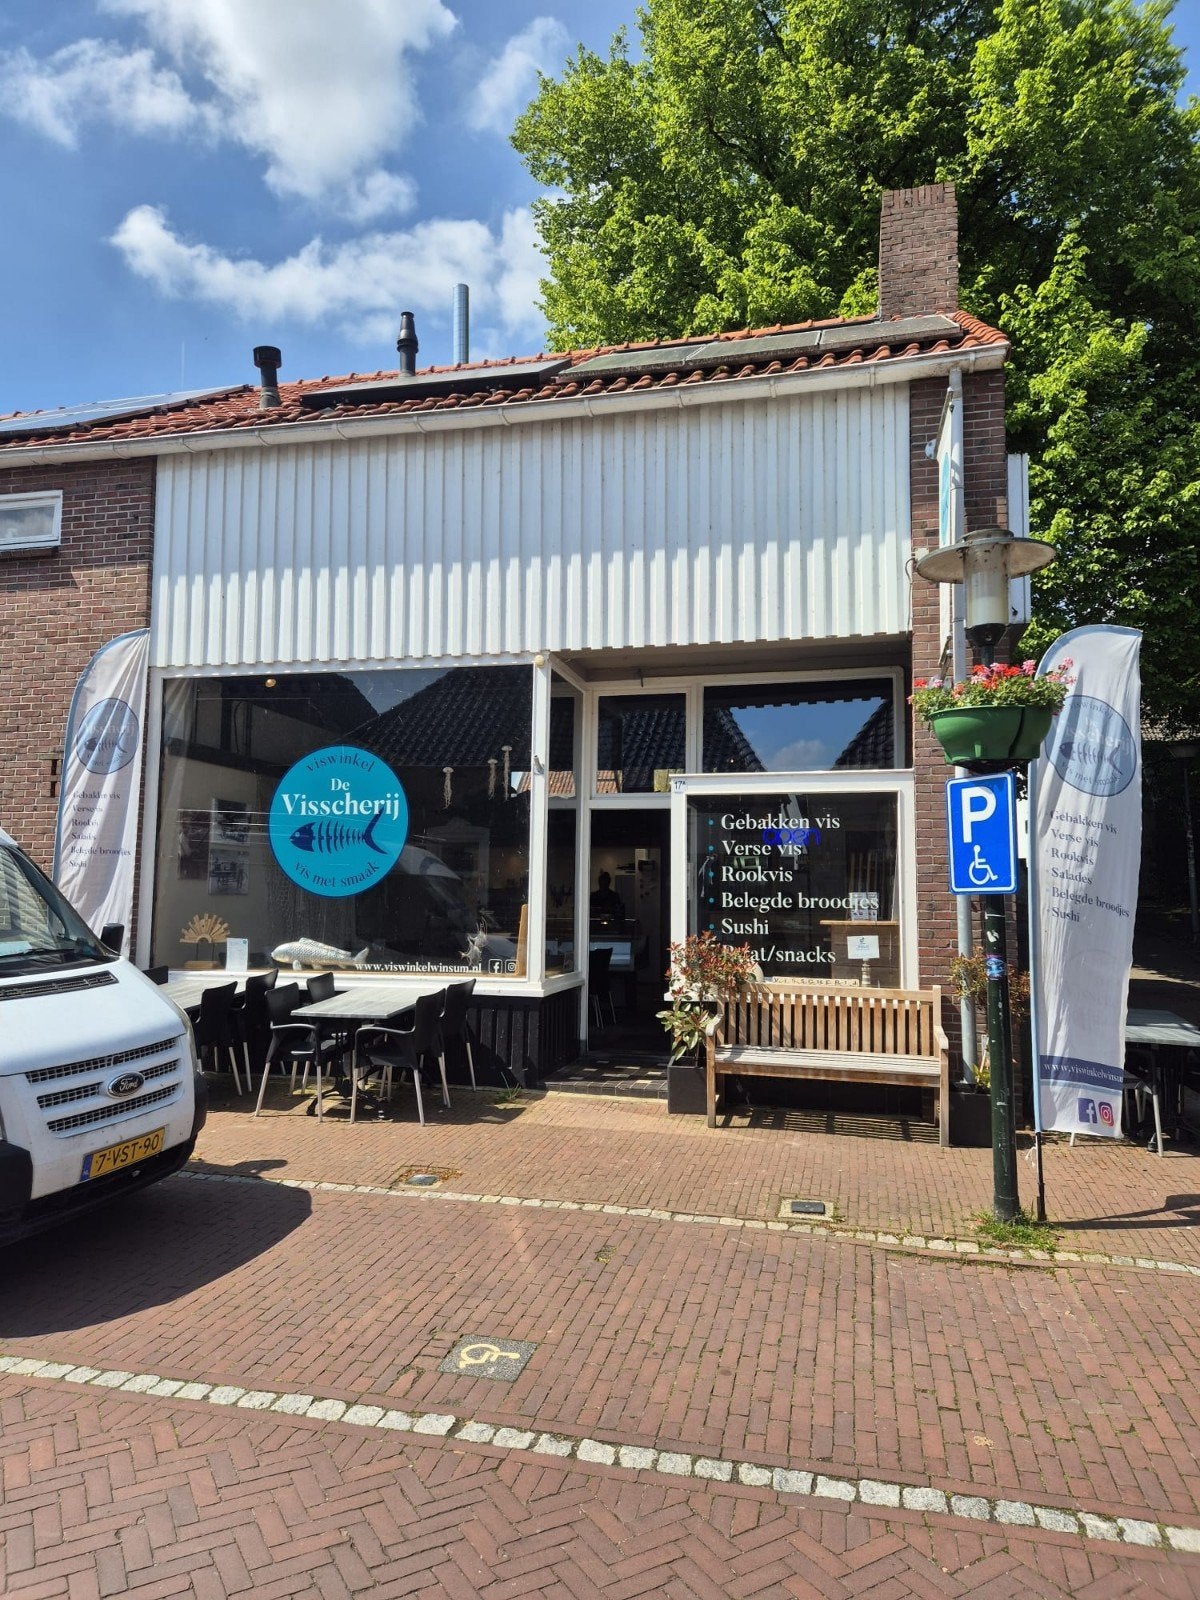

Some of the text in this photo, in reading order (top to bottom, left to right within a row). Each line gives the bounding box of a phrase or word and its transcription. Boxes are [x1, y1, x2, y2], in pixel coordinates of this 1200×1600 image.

[306, 752, 375, 773] viswinkel
[330, 778, 350, 791] De
[281, 793, 400, 821] Visscherij
[961, 786, 997, 843] P
[720, 813, 841, 830] Gebakken vis
[1105, 823, 1119, 835] vis
[1051, 828, 1083, 843] Verse
[721, 840, 802, 856] Verse vis
[1051, 847, 1095, 866] Rookvis
[295, 861, 380, 888] vis met smaak
[721, 865, 794, 883] Rookvis
[1051, 867, 1094, 885] Salades
[721, 891, 880, 914] Belegde broodjes
[1052, 886, 1130, 918] Belegde broodjes
[1052, 906, 1080, 922] Sushi
[721, 918, 770, 935] Sushi
[722, 944, 836, 963] at/snacks
[354, 962, 482, 973] www.viswinkelwinsum.nl
[119, 1078, 138, 1091] Ford
[97, 1134, 160, 1172] 7-VST-90
